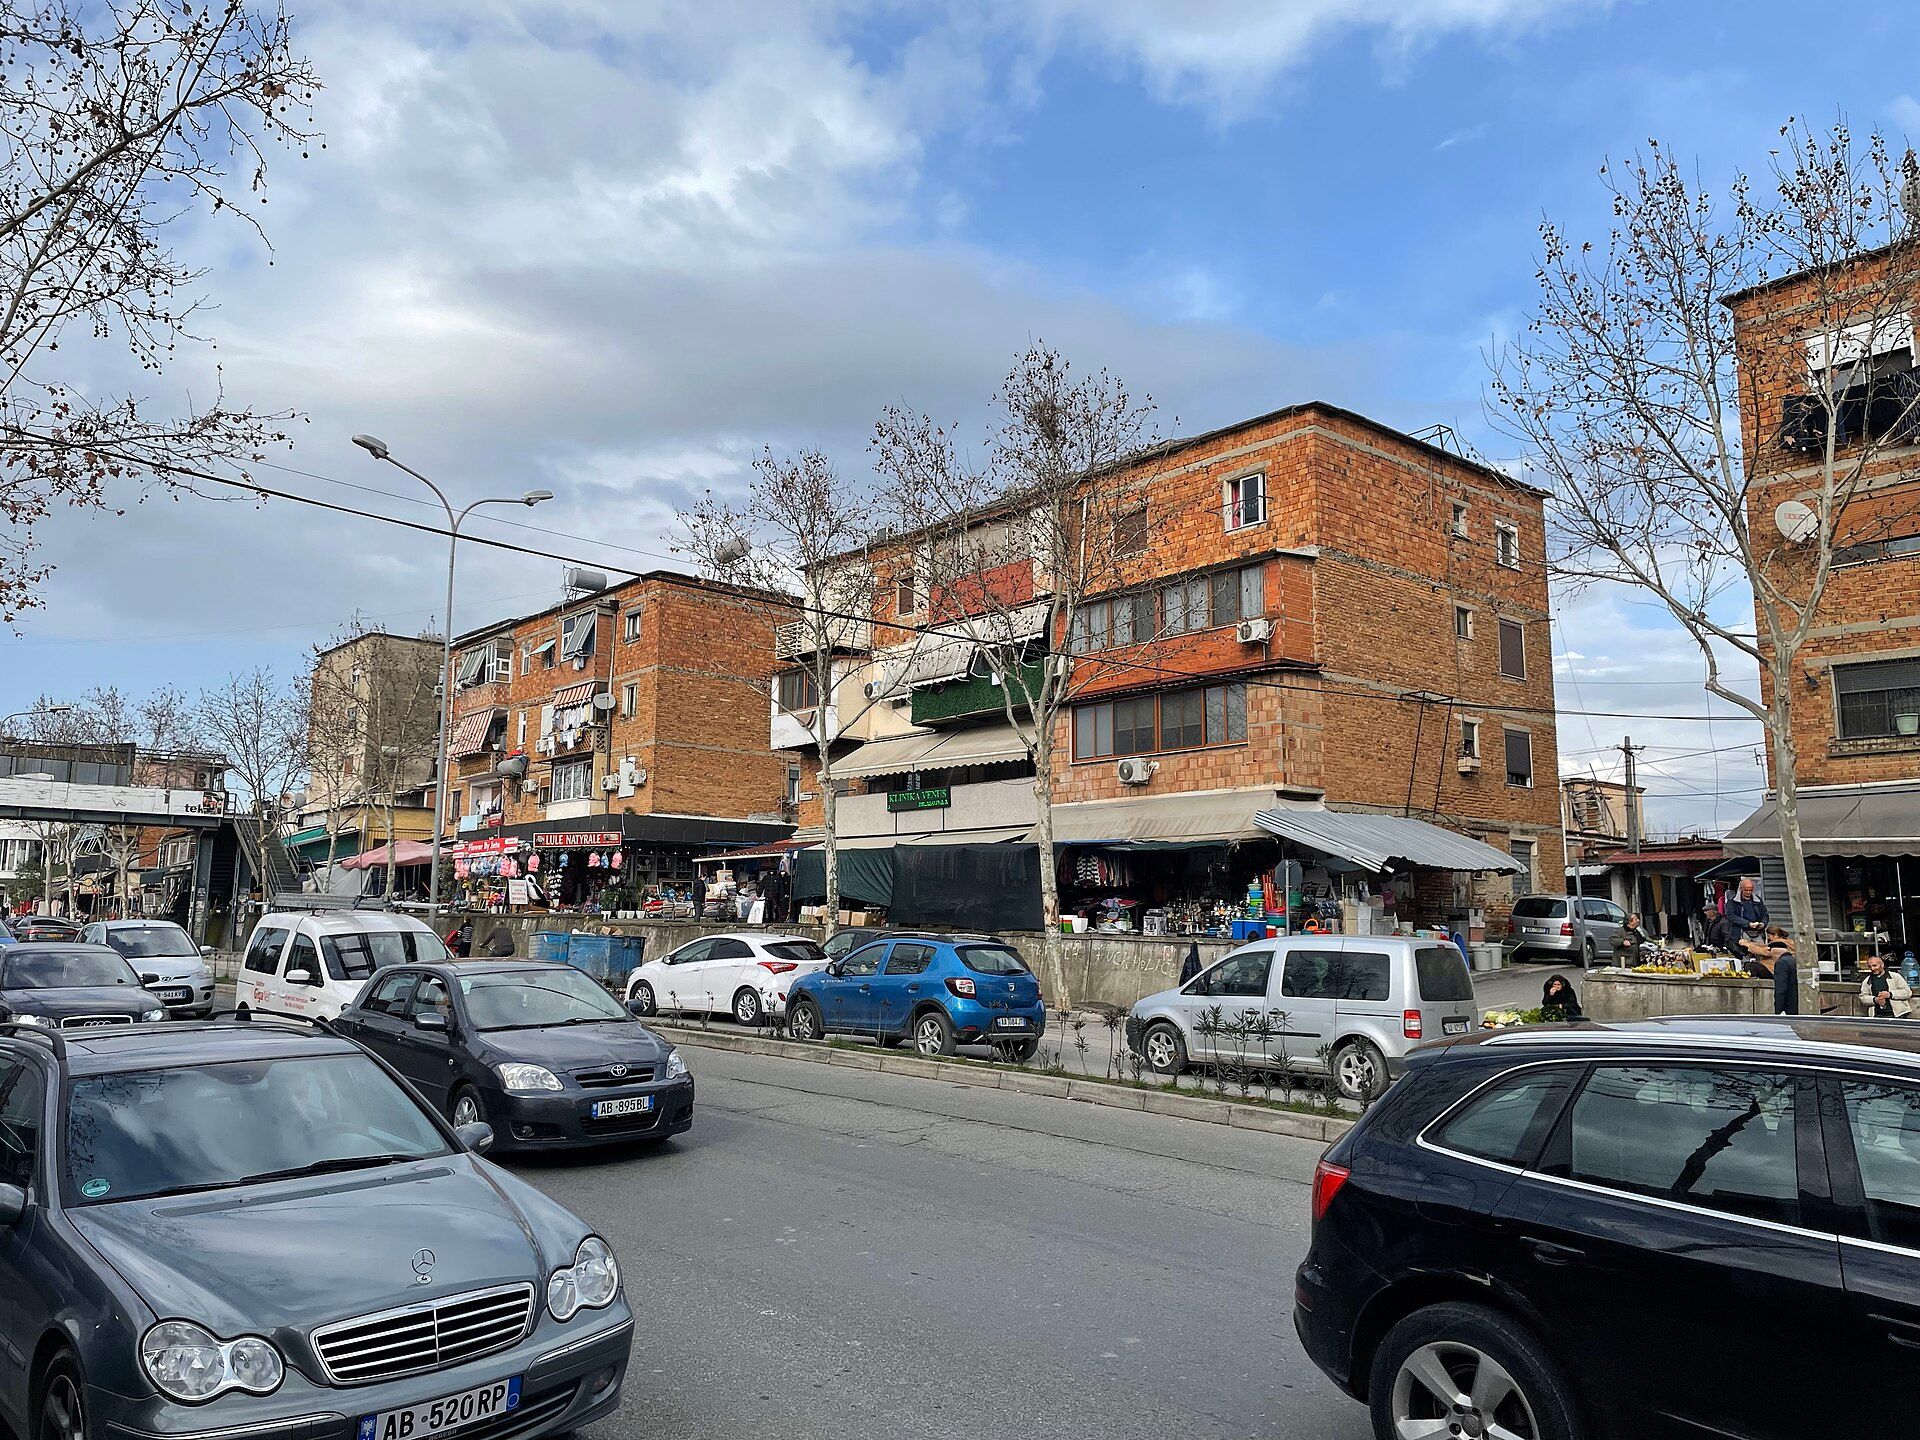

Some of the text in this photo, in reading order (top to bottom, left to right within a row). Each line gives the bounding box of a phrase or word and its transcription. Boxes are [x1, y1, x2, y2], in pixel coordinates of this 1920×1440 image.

[888, 792, 920, 803] KLINIKA
[921, 788, 947, 800] VENUS
[545, 834, 563, 846] LULE
[565, 833, 602, 845] NATYRALE
[601, 1097, 648, 1115] AB 895BL
[382, 1384, 506, 1440] AB 520RP
